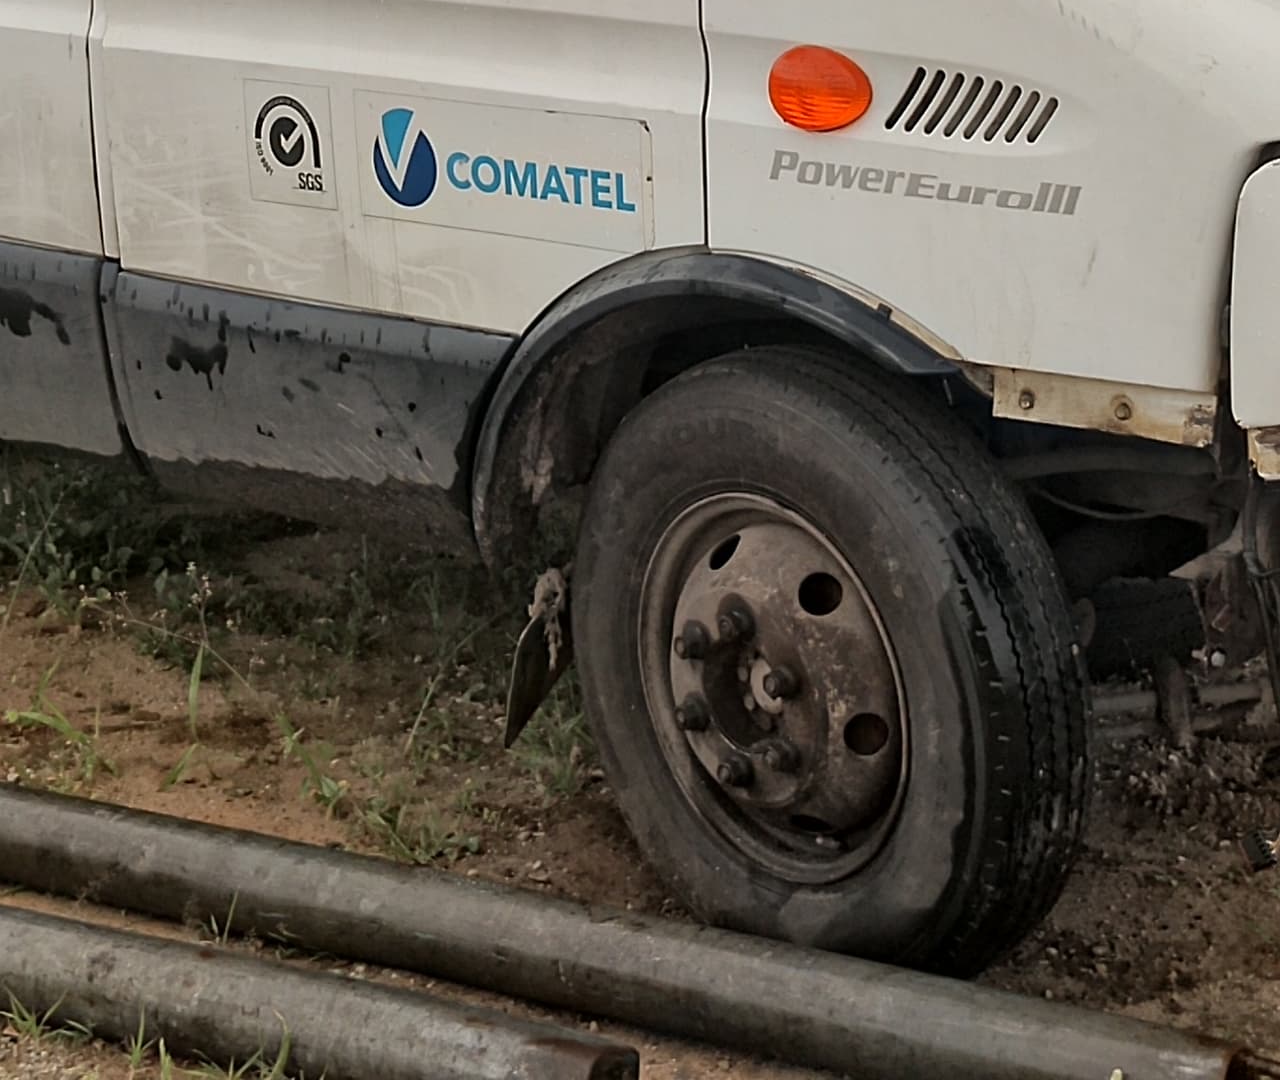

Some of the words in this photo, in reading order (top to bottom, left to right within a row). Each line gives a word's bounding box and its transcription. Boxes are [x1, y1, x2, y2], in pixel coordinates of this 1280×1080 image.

[298, 172, 323, 191] SGS
[446, 151, 637, 213] COMATEL
[769, 149, 1082, 215] PowerEuroIII
